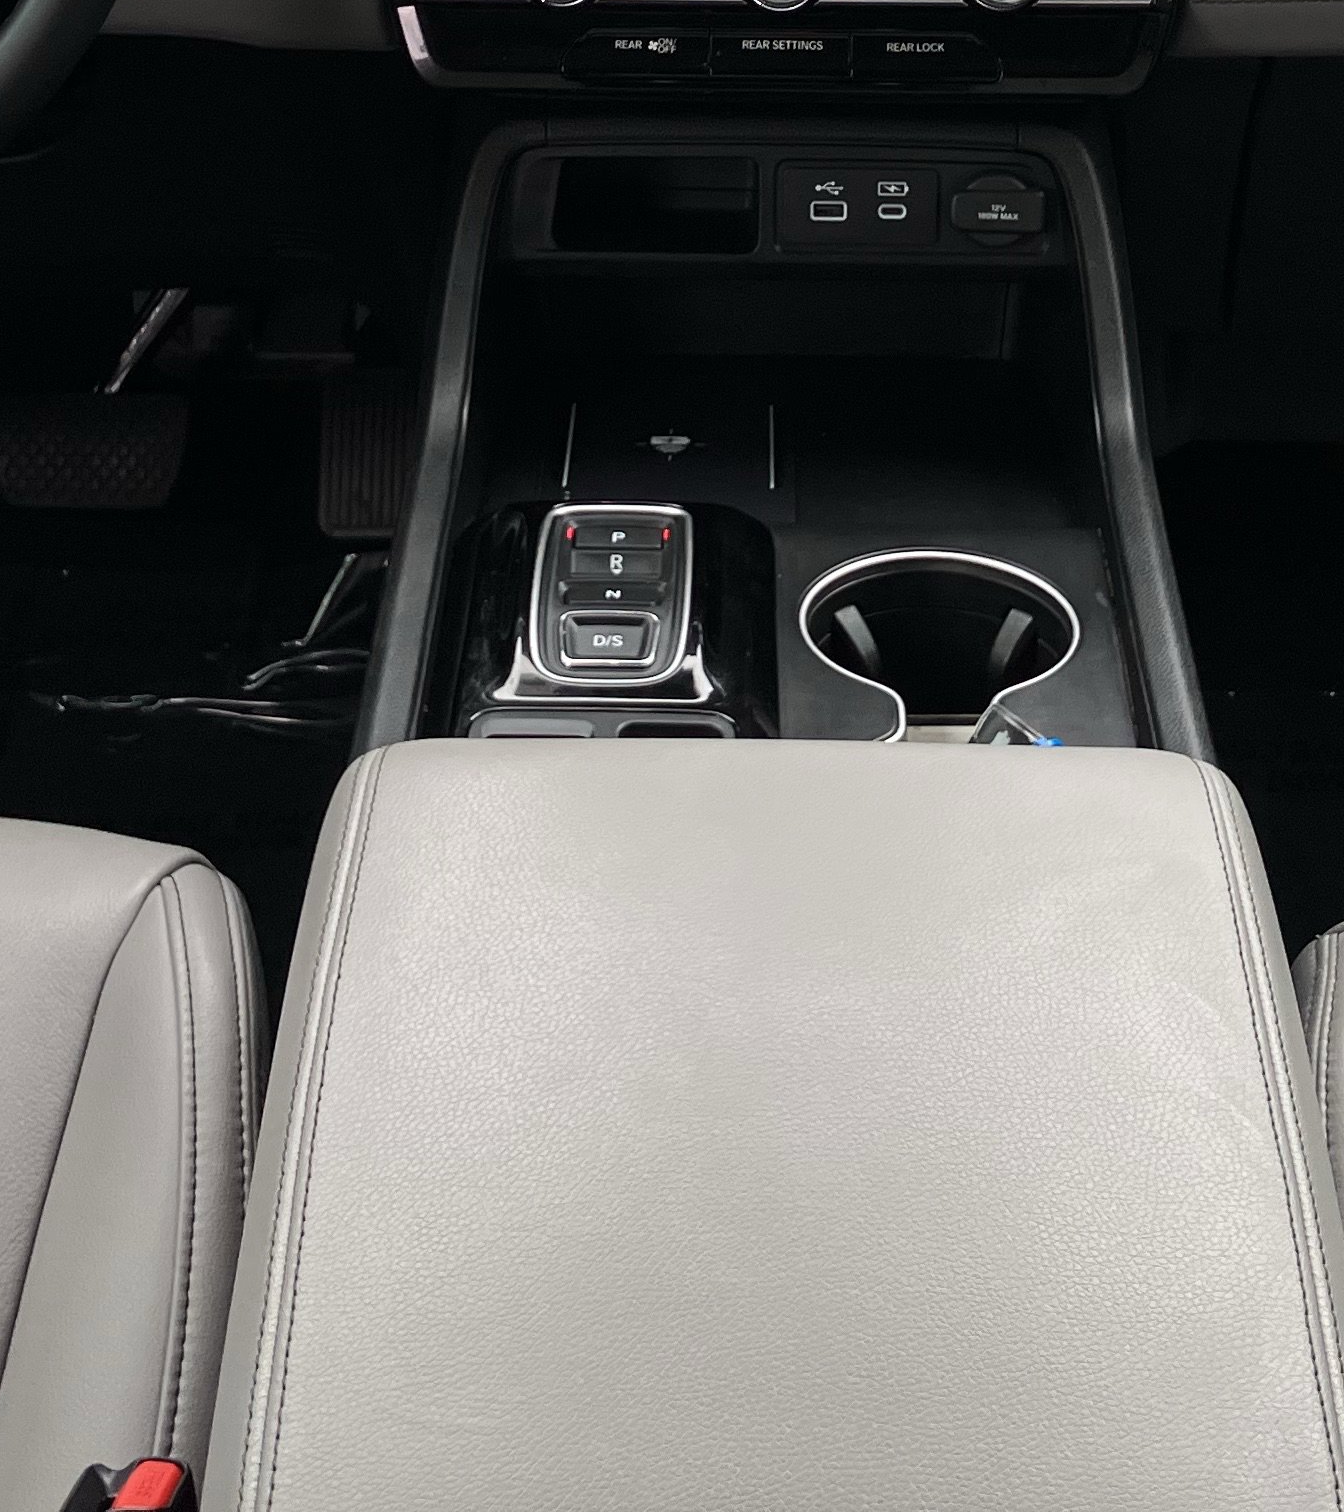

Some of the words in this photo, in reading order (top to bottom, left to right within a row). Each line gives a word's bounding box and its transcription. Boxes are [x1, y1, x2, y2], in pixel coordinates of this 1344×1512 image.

[615, 40, 642, 49] REAR
[657, 38, 676, 48] ON/
[742, 40, 770, 49] REAR
[773, 40, 823, 50] SETTINGS
[887, 43, 914, 52] REAR
[917, 43, 944, 52] LOCK
[658, 45, 676, 53] OFF
[991, 204, 1006, 212] 12V
[1000, 212, 1018, 220] MAX
[612, 532, 625, 542] P
[610, 554, 623, 569] R
[606, 590, 621, 598] N
[593, 634, 623, 648] D/S
